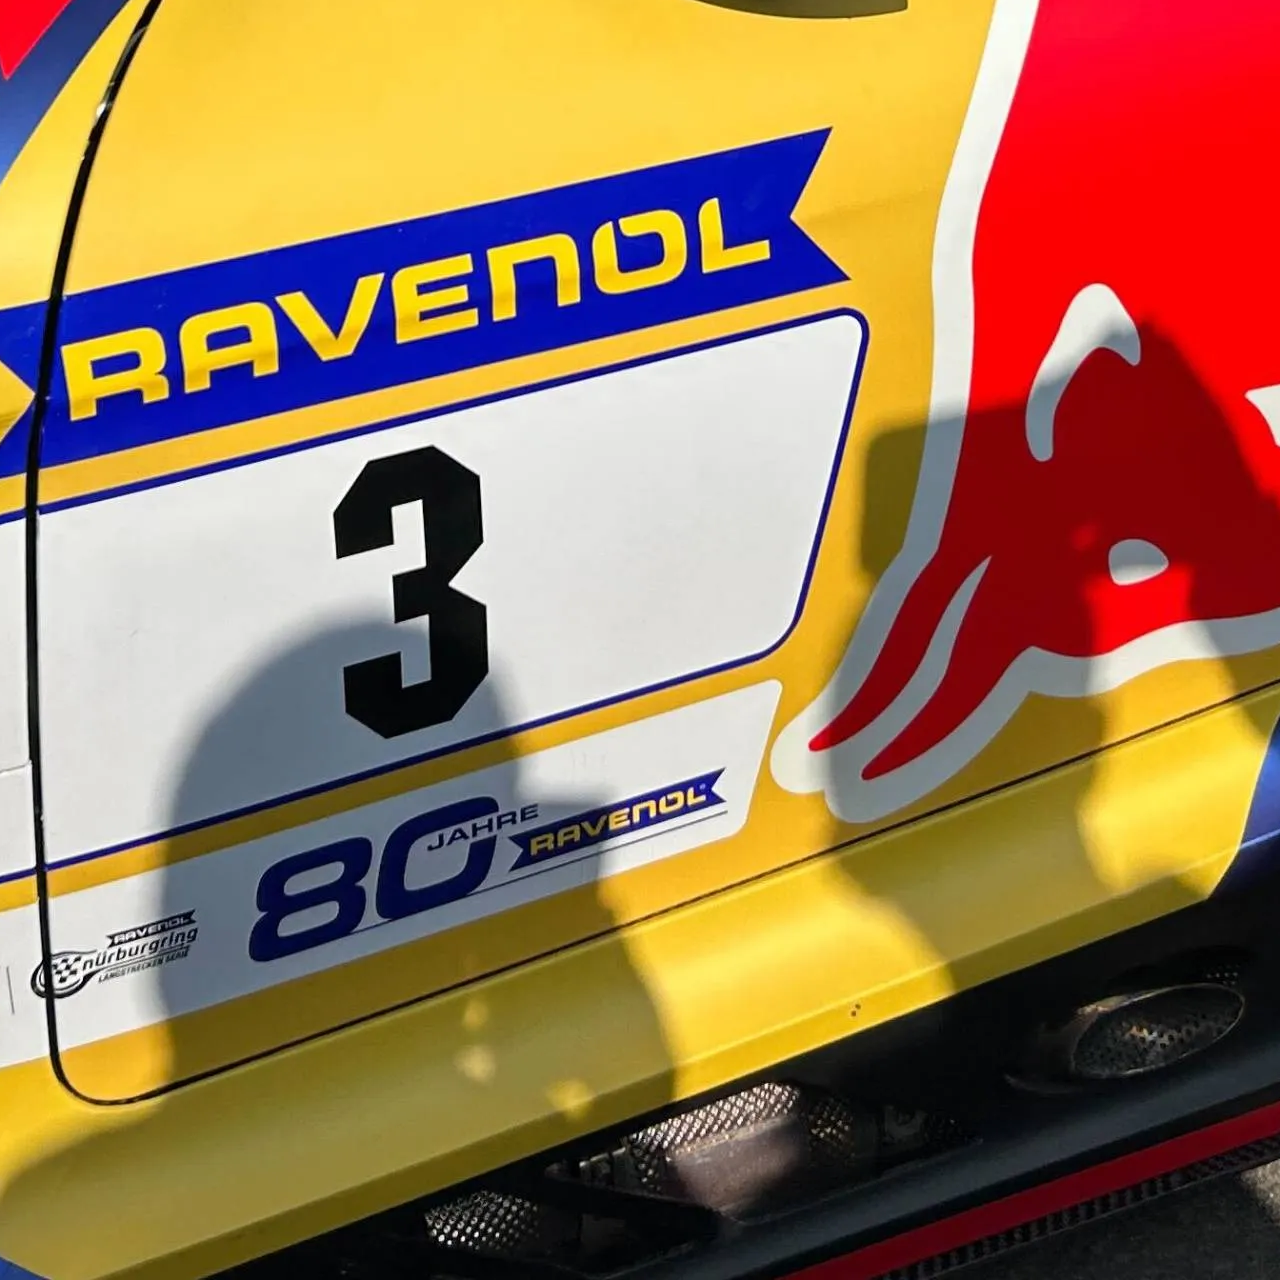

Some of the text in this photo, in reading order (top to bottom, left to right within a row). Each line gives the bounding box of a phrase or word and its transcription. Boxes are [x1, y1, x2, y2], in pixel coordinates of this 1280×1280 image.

[60, 195, 772, 422] RAVENOL
[332, 444, 489, 741] 3
[248, 795, 500, 963] 80
[426, 802, 539, 853] JAHRE
[82, 927, 198, 972] nürburgring
[113, 916, 190, 945] RAVENOL
